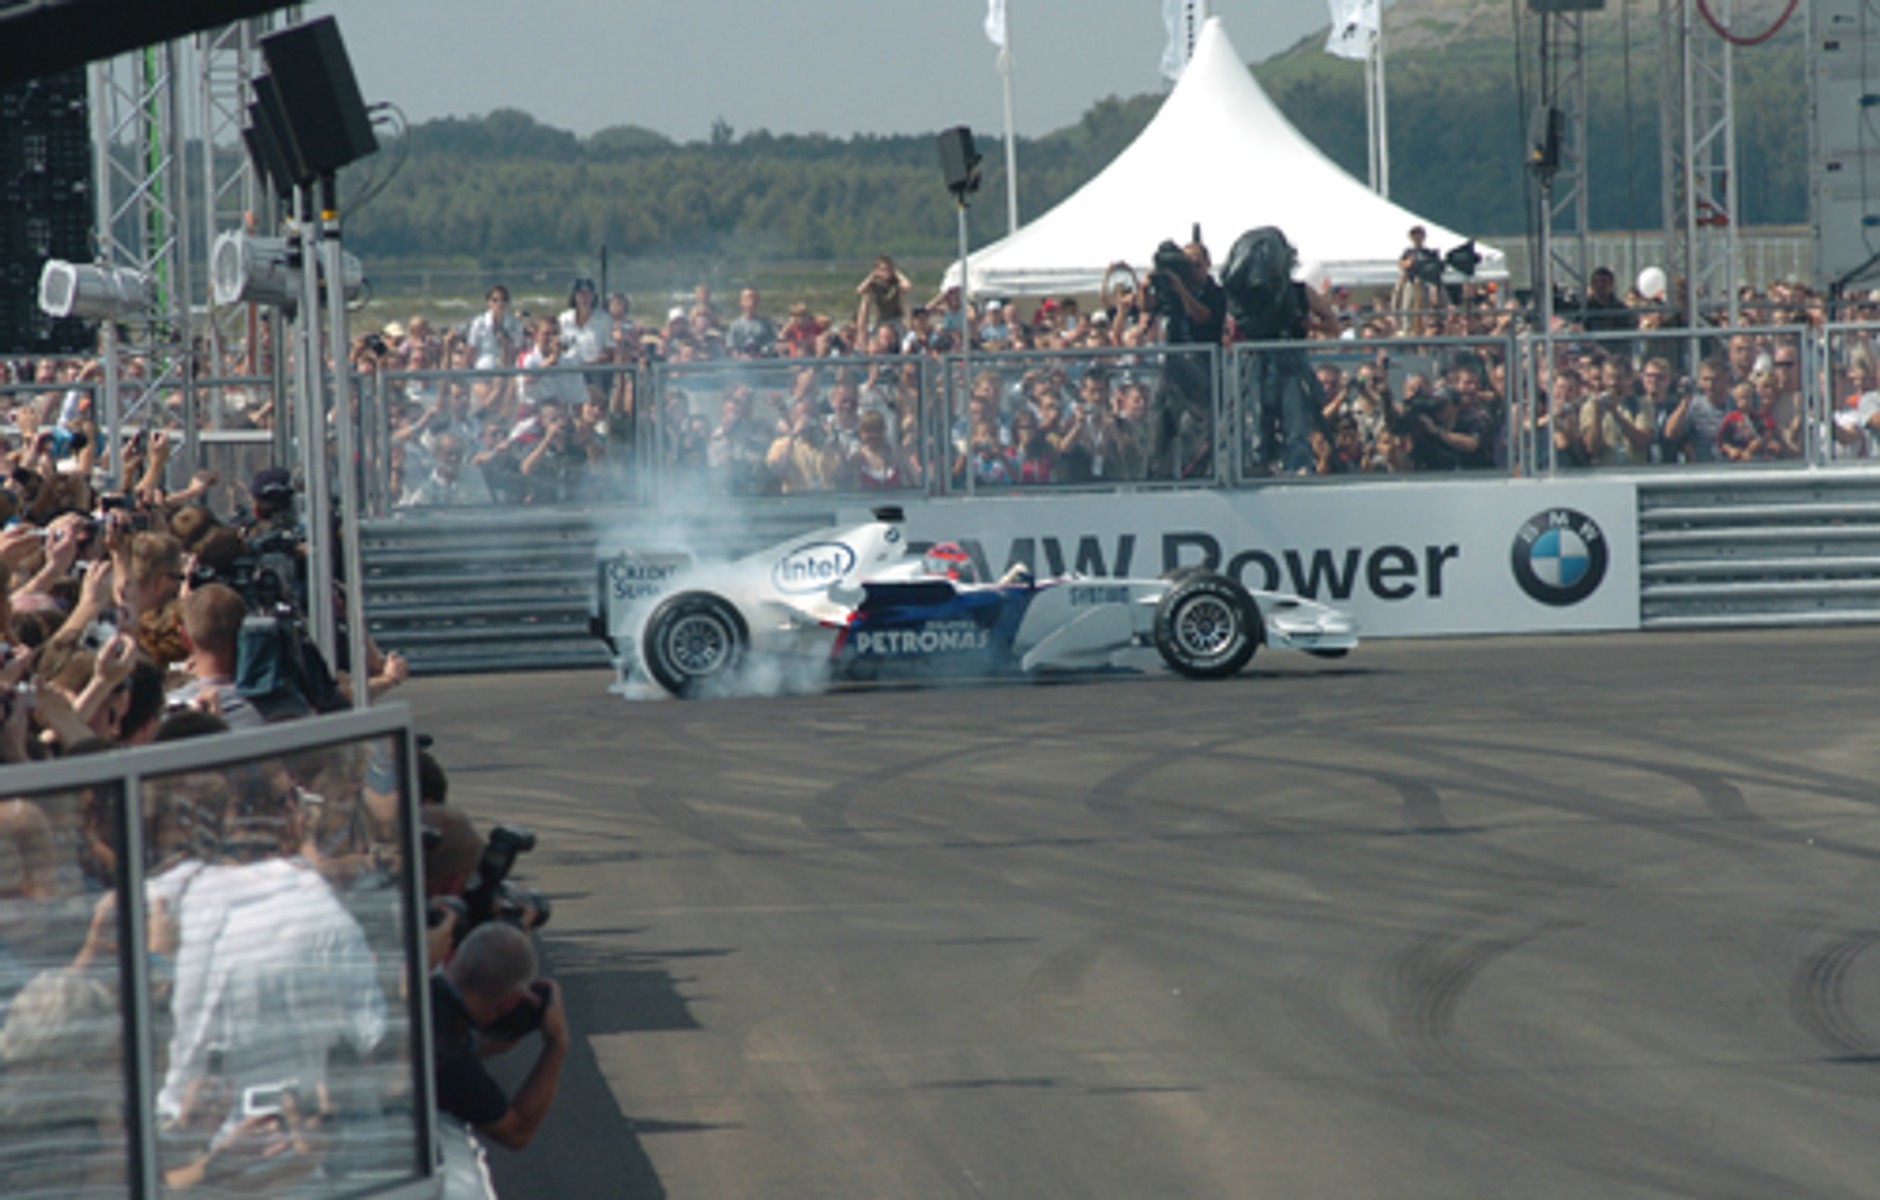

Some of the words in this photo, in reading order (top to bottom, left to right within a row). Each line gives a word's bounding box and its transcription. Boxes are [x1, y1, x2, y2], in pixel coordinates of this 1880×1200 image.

[1518, 510, 1601, 545] BMW
[1161, 530, 1460, 601] Power
[856, 629, 990, 654] PETRONAS
